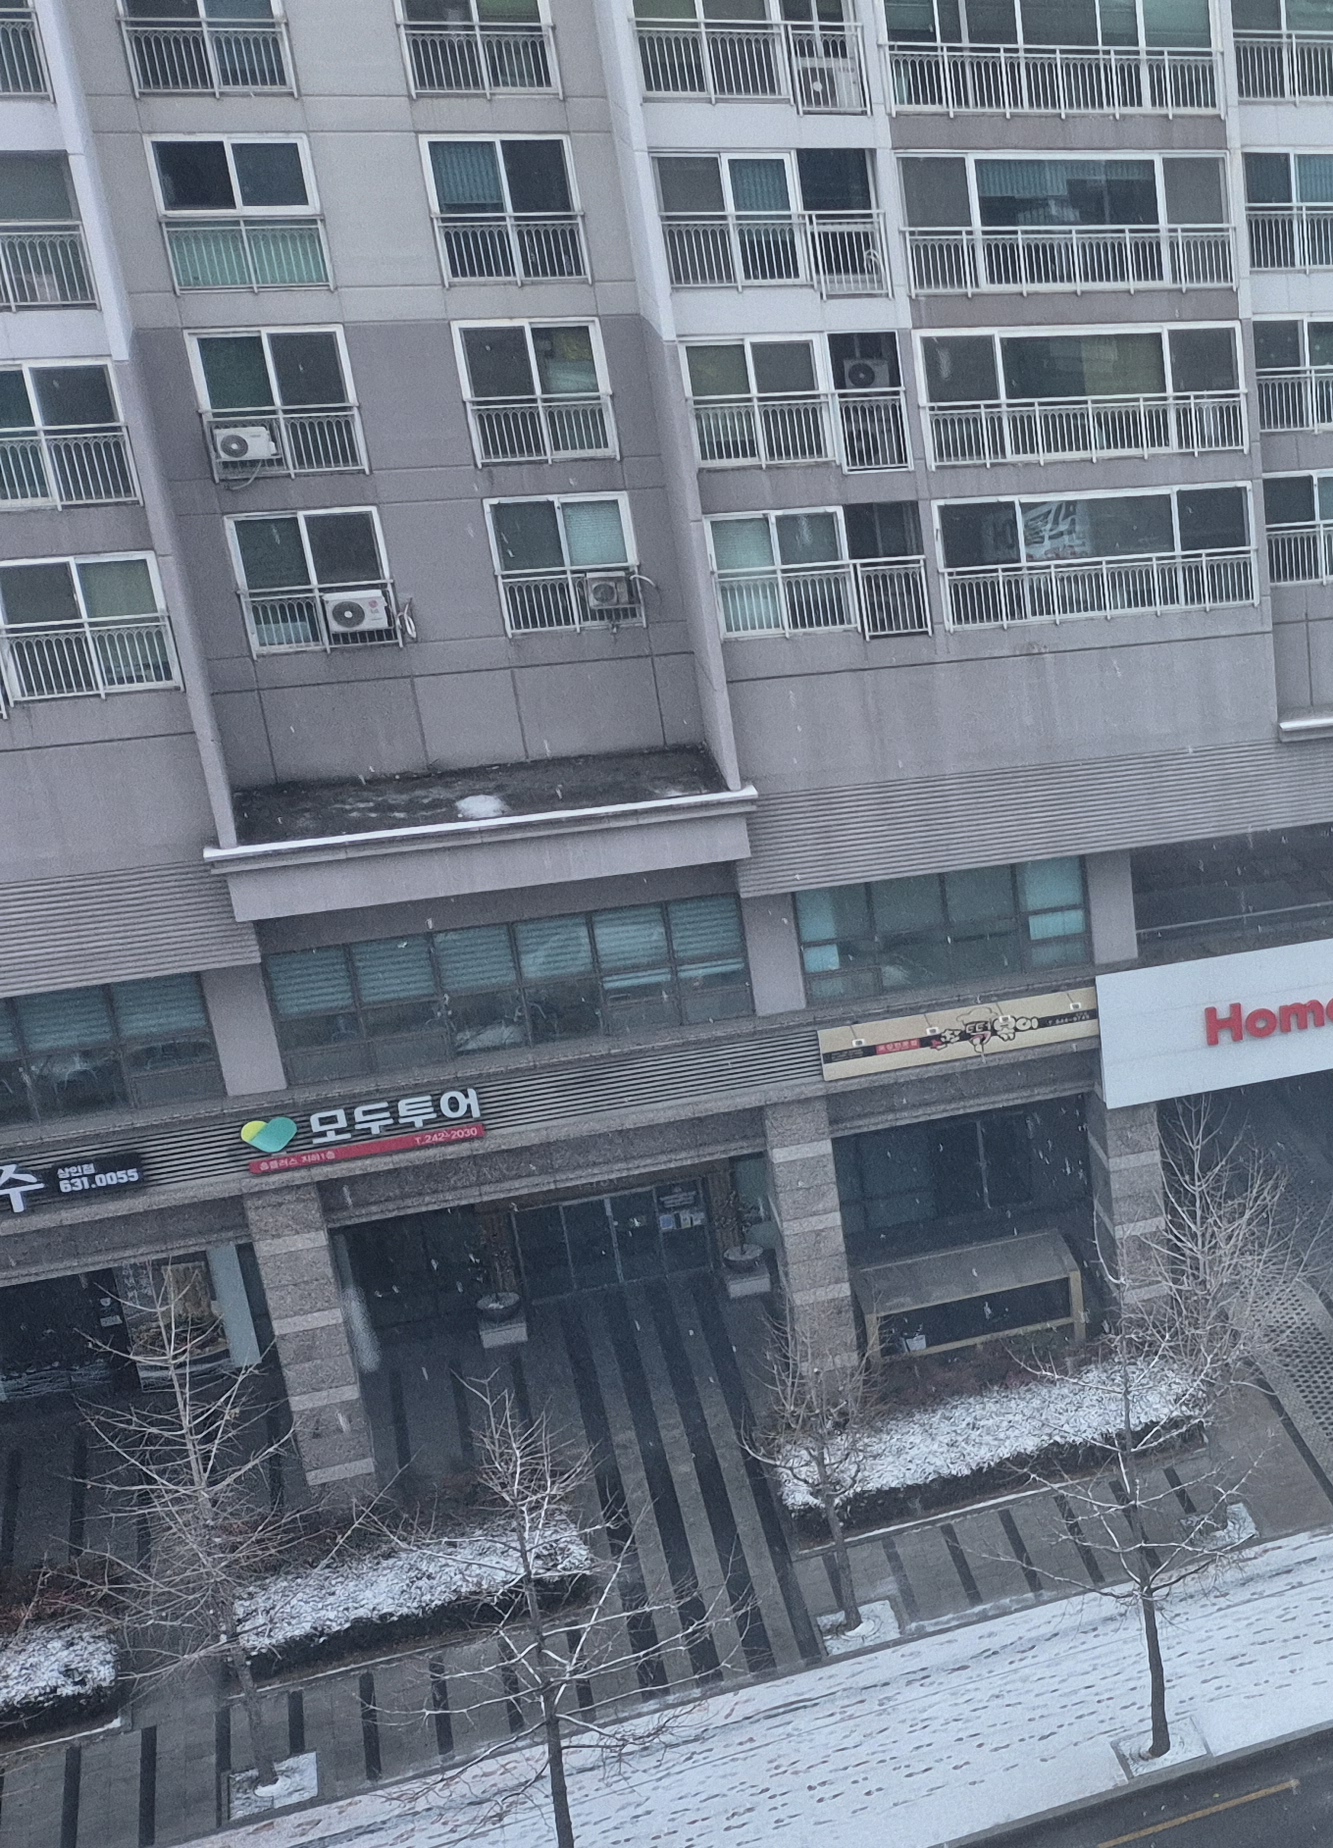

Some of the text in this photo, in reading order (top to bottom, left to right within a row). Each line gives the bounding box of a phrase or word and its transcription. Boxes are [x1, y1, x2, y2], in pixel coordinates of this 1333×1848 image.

[309, 1088, 481, 1145] 모두투어
[57, 1163, 96, 1179] 상인점
[59, 1168, 139, 1193] 631.0055
